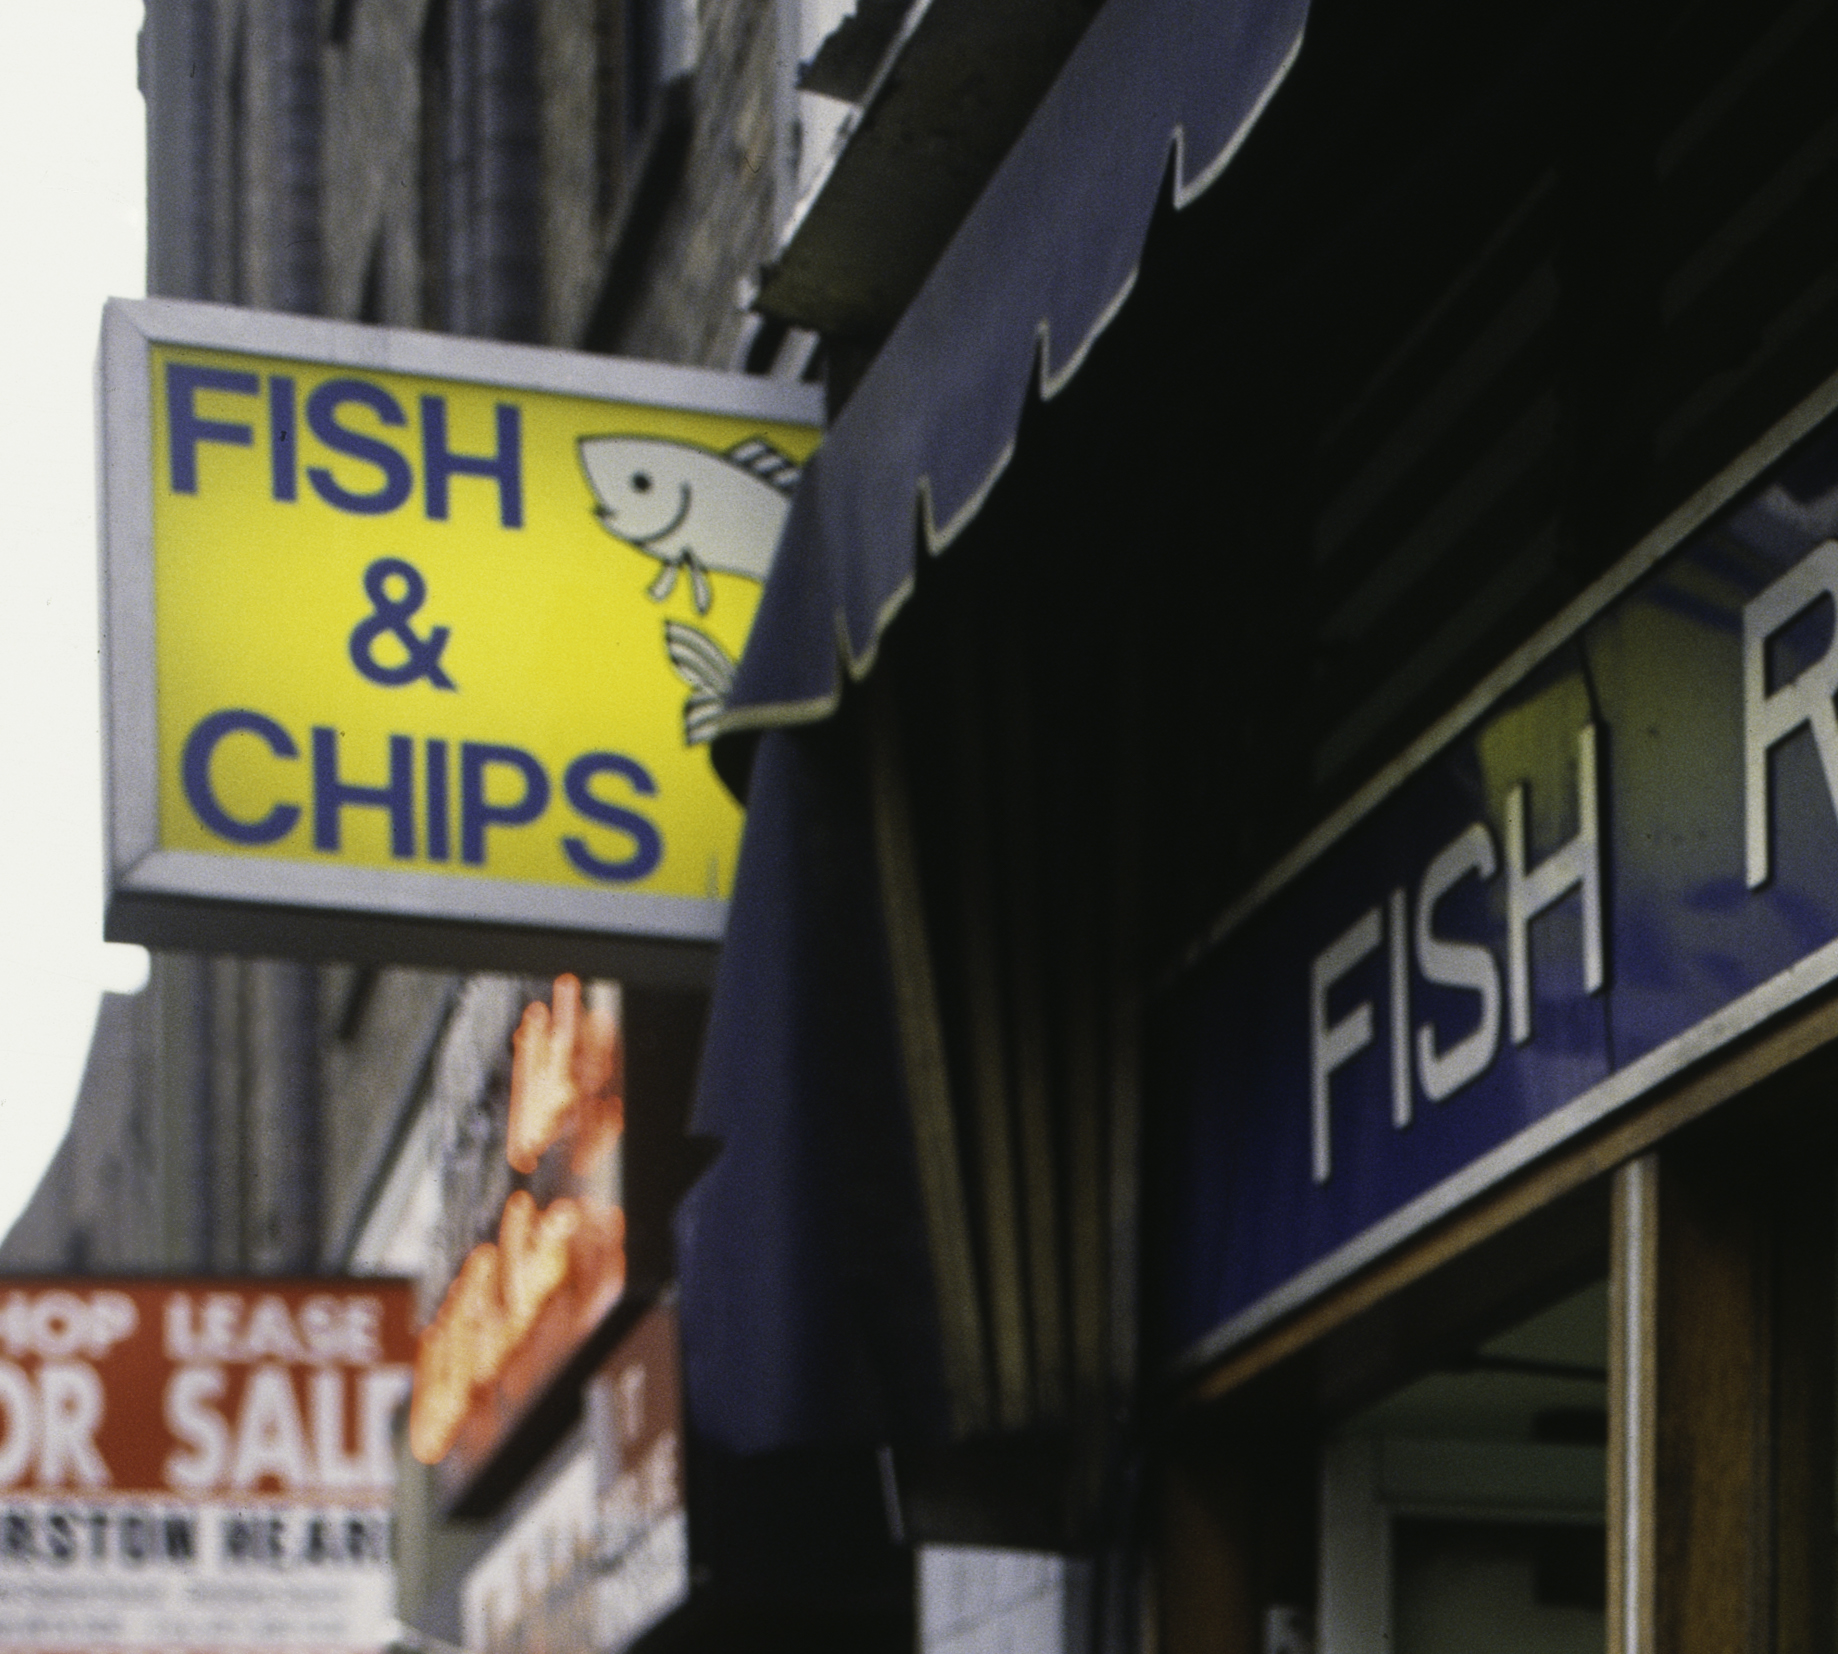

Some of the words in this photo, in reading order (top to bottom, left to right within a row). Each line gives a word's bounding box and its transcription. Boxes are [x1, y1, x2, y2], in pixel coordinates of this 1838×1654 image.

[163, 361, 526, 530] FISH
[348, 557, 460, 692] &
[180, 708, 665, 883] CHIPS
[1312, 722, 1603, 1184] FISH
[163, 1292, 383, 1361] LEASE
